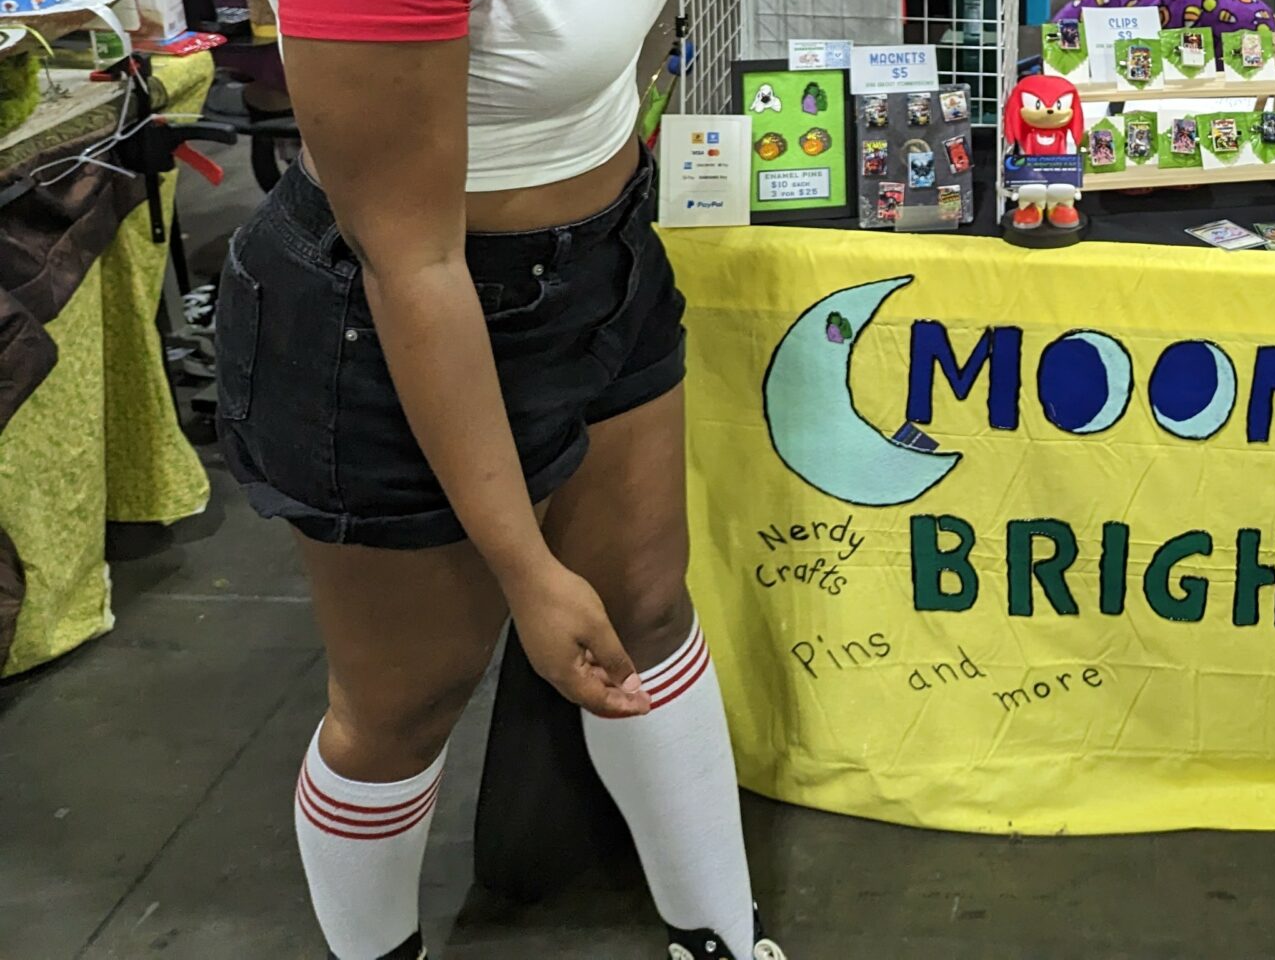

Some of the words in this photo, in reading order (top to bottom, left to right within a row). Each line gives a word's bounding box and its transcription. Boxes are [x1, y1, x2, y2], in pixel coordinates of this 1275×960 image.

[1108, 18, 1138, 28] CLIPS
[870, 52, 926, 64] MAGNETS
[892, 66, 908, 79] $5
[765, 172, 799, 180] ENAMEL
[772, 180, 788, 188] $10
[772, 190, 778, 198] 3
[799, 188, 818, 196] $25
[757, 514, 865, 560] Nerdy
[755, 557, 848, 596] Crafts
[790, 631, 891, 680] Pins
[908, 644, 988, 691] and
[993, 666, 1104, 712] more
